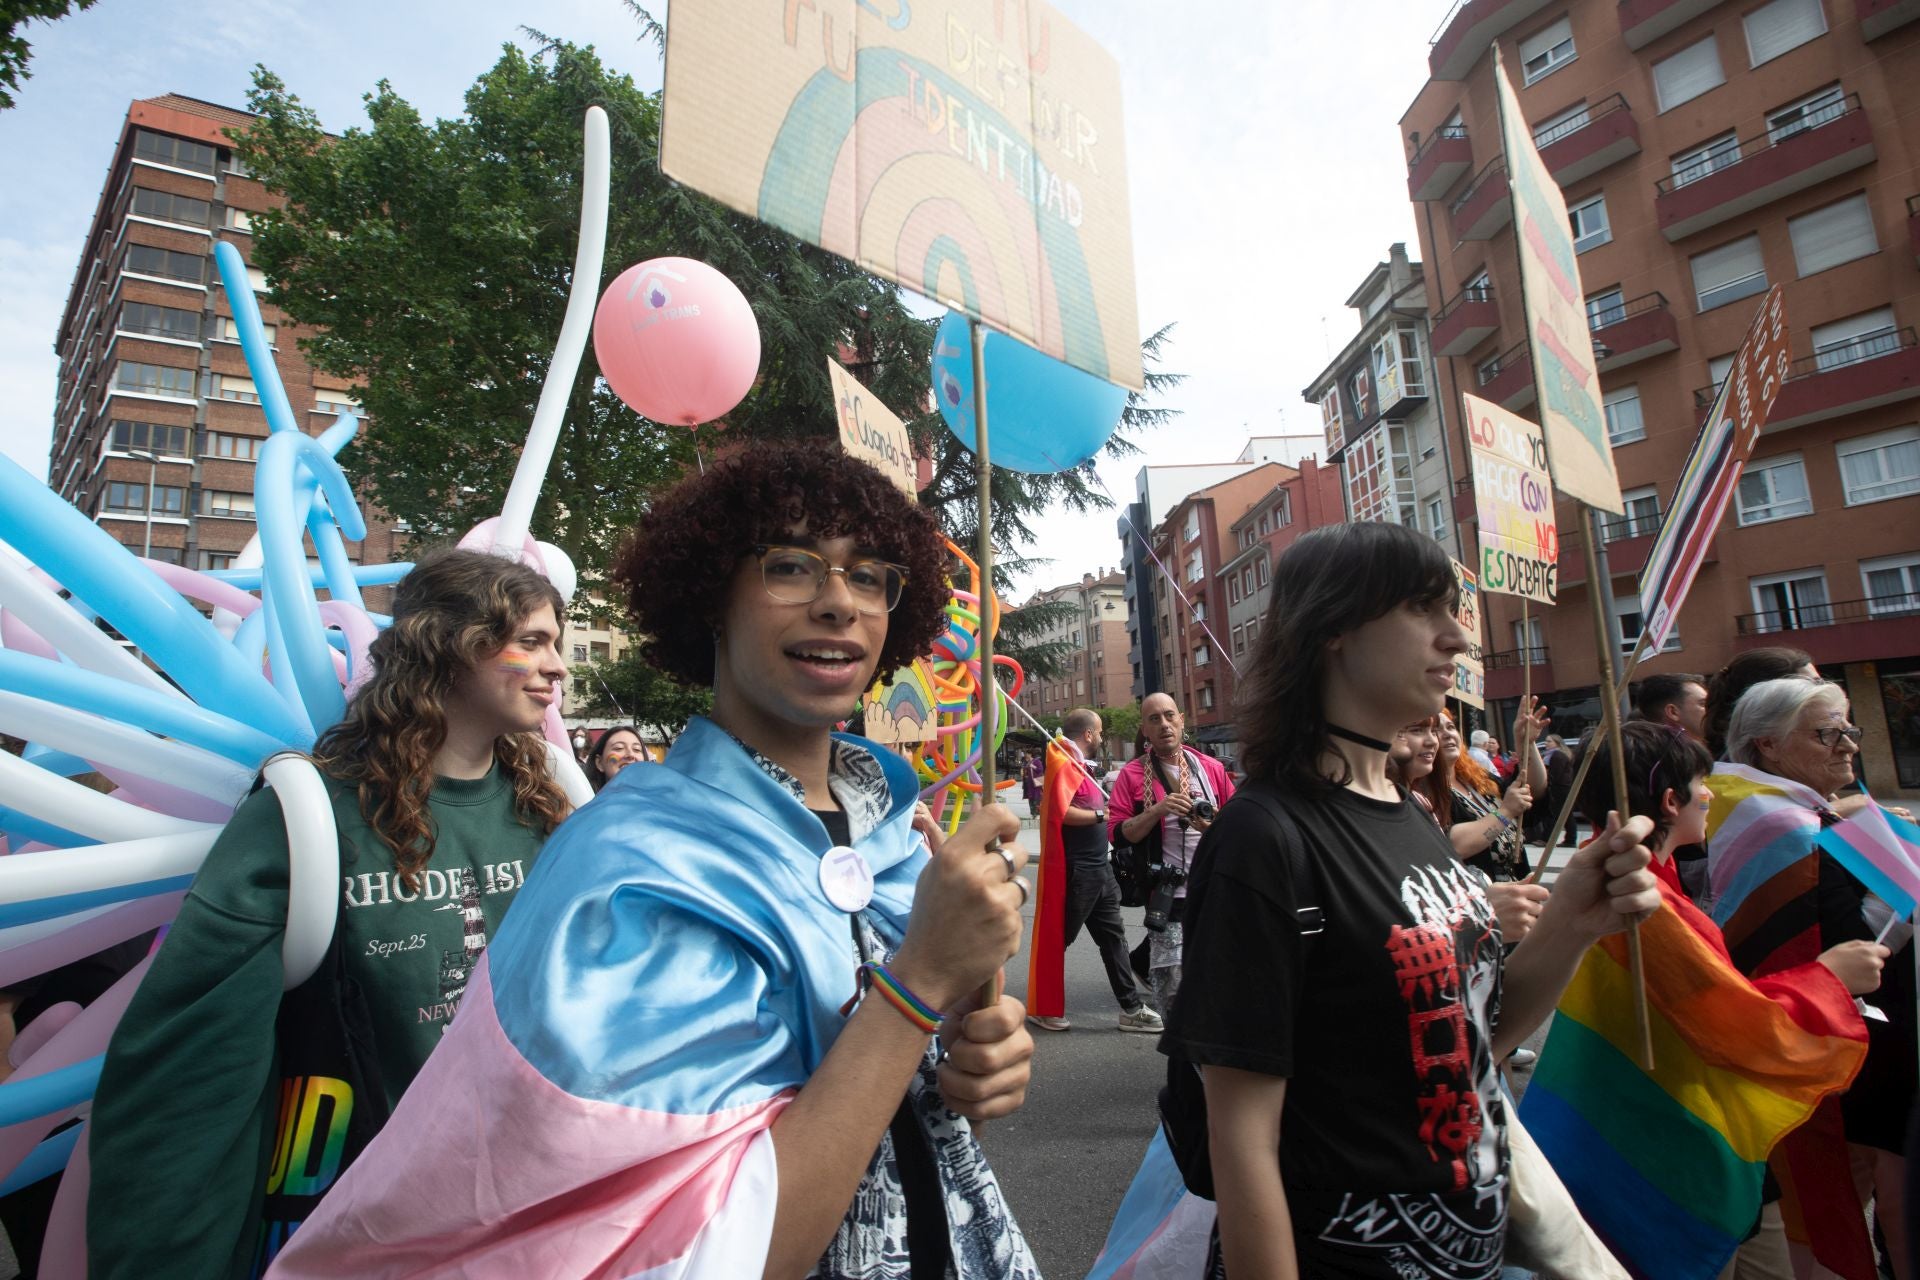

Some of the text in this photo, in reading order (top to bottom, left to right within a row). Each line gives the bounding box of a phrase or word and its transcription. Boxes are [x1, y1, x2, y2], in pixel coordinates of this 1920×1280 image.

[662, 304, 701, 321] TRANS
[1465, 396, 1547, 472] LO QUE YO
[1520, 471, 1548, 513] CON
[1535, 518, 1559, 563] NO
[1483, 546, 1505, 589] ES
[1506, 552, 1557, 603] DEBATE
